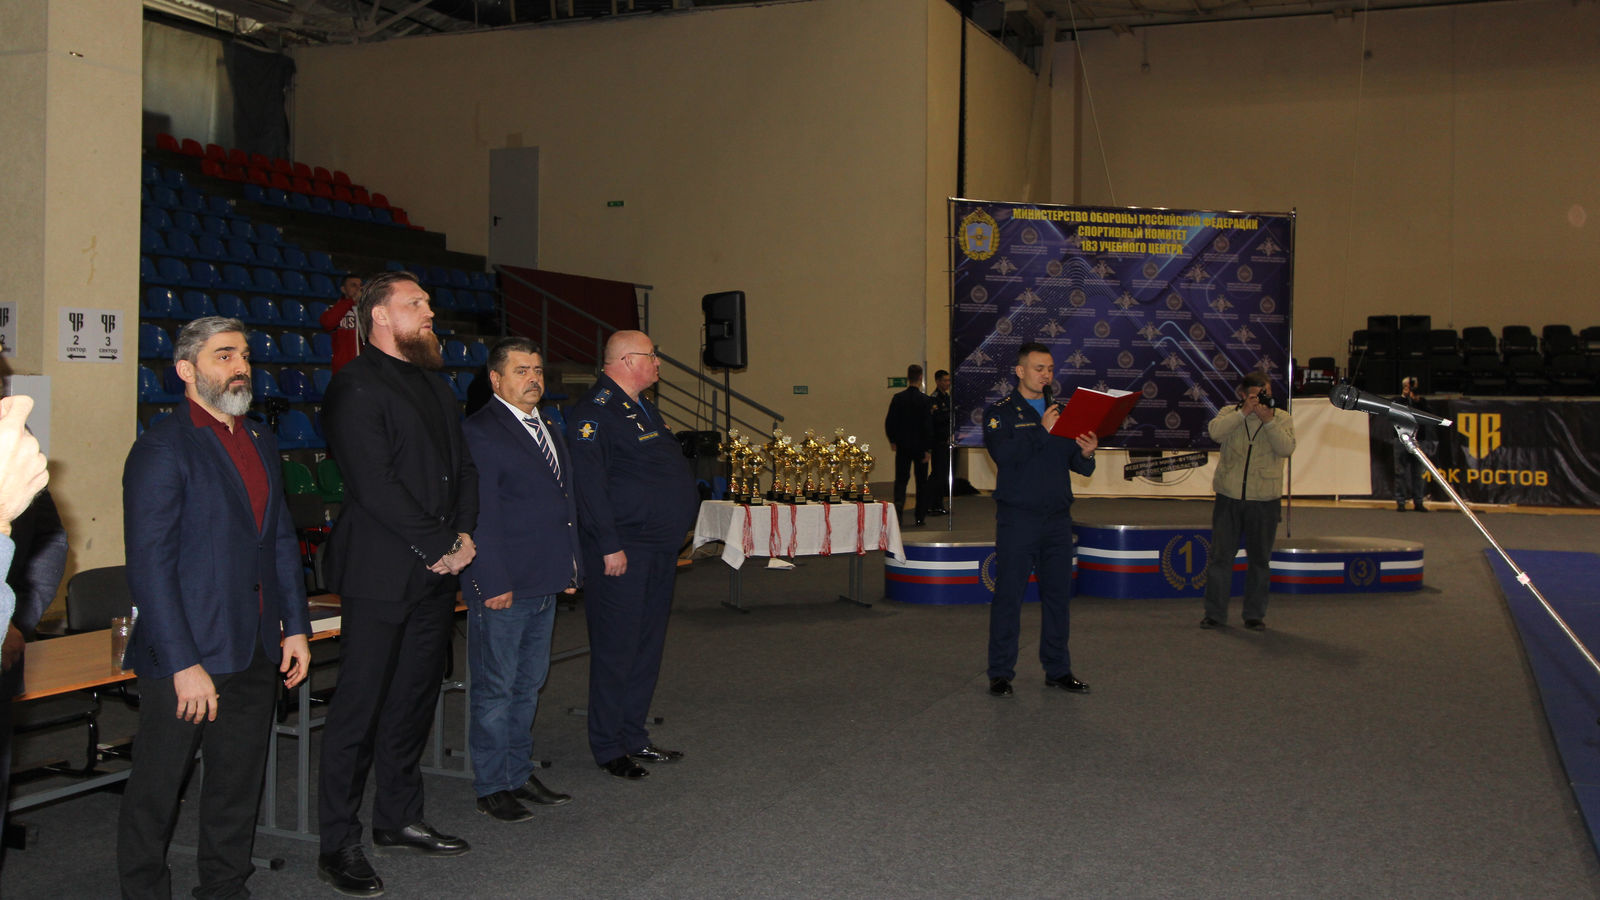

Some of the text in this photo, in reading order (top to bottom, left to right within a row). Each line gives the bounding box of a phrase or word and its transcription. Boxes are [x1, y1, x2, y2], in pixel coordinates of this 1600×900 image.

[1012, 208, 1259, 231] МИНИСТЕРСТВО ОБОРОНЫ РОССИЙСКОЙ ФЕДЕРАЦИИ
[1077, 225, 1188, 241] СПОРТИВНЫЙ КОМИТЕТ
[1081, 240, 1185, 255] 183 УЧЕБНОГО ЦЕНТРА
[73, 335, 80, 345] 2
[105, 336, 111, 346] 3
[1467, 468, 1548, 487] РОСТОВ
[1178, 540, 1193, 574] 1
[1357, 560, 1369, 578] 3
